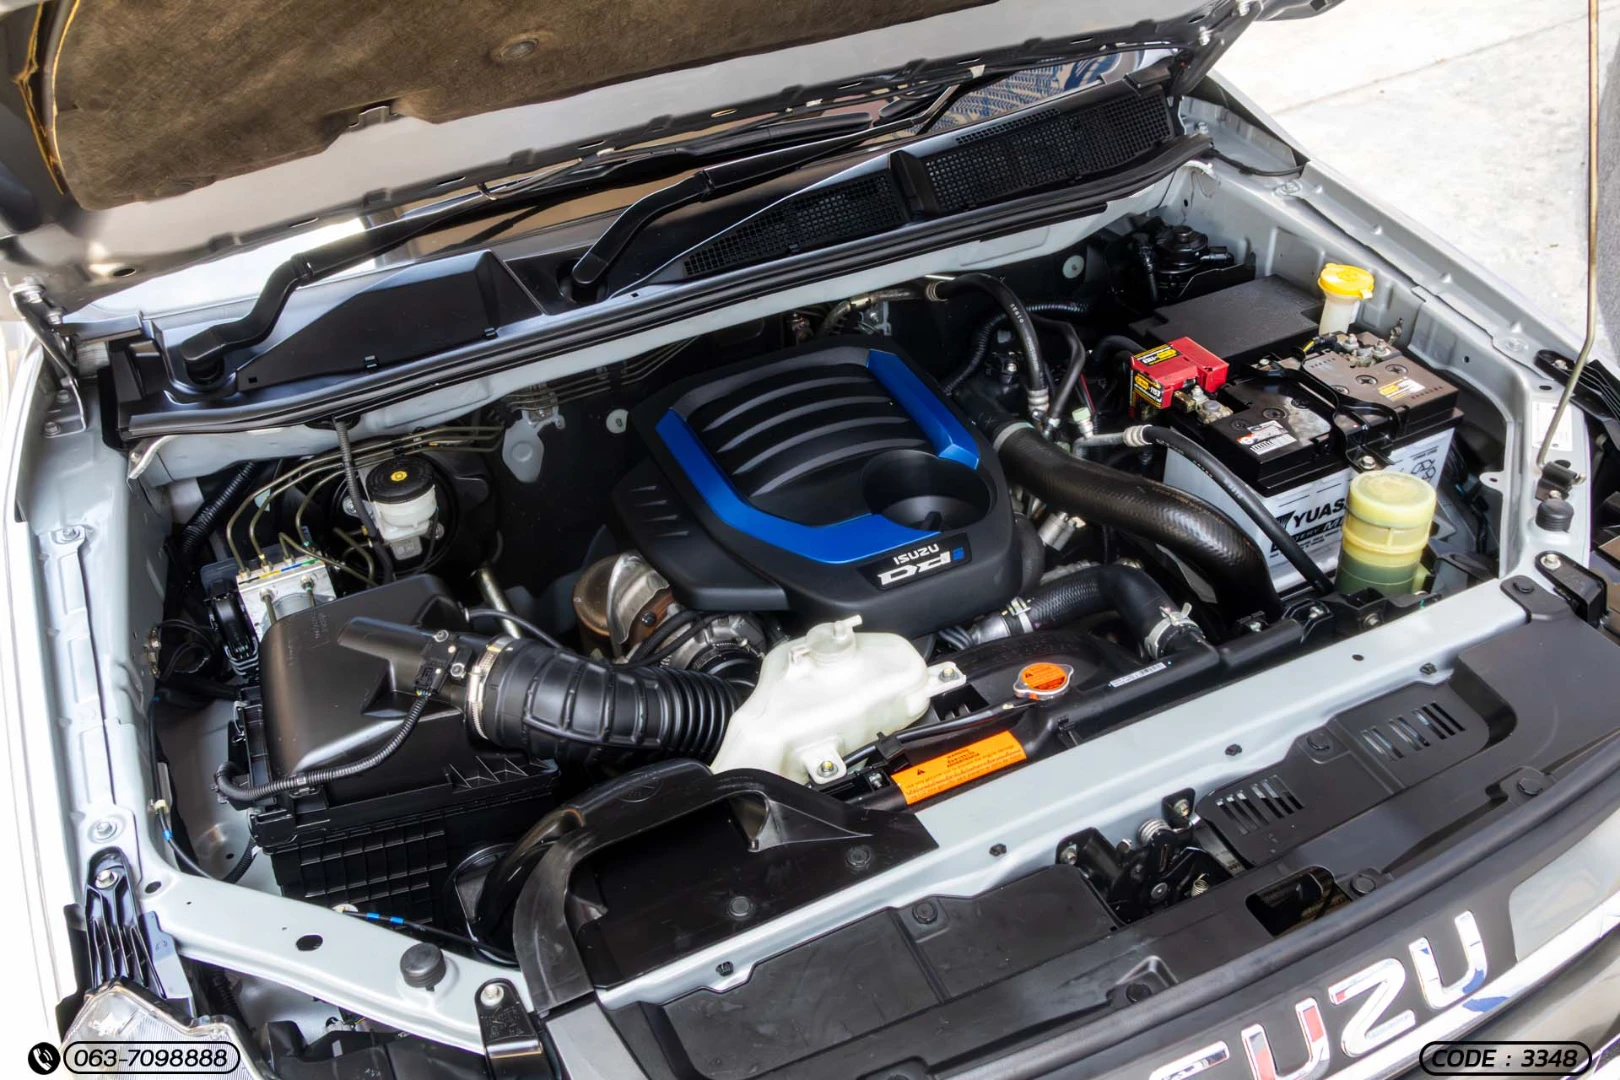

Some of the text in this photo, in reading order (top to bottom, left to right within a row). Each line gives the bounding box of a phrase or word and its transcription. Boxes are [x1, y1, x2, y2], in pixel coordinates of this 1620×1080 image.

[1294, 498, 1348, 528] YUAS
[893, 543, 940, 565] ISUZU
[1149, 909, 1489, 1080] UZU
